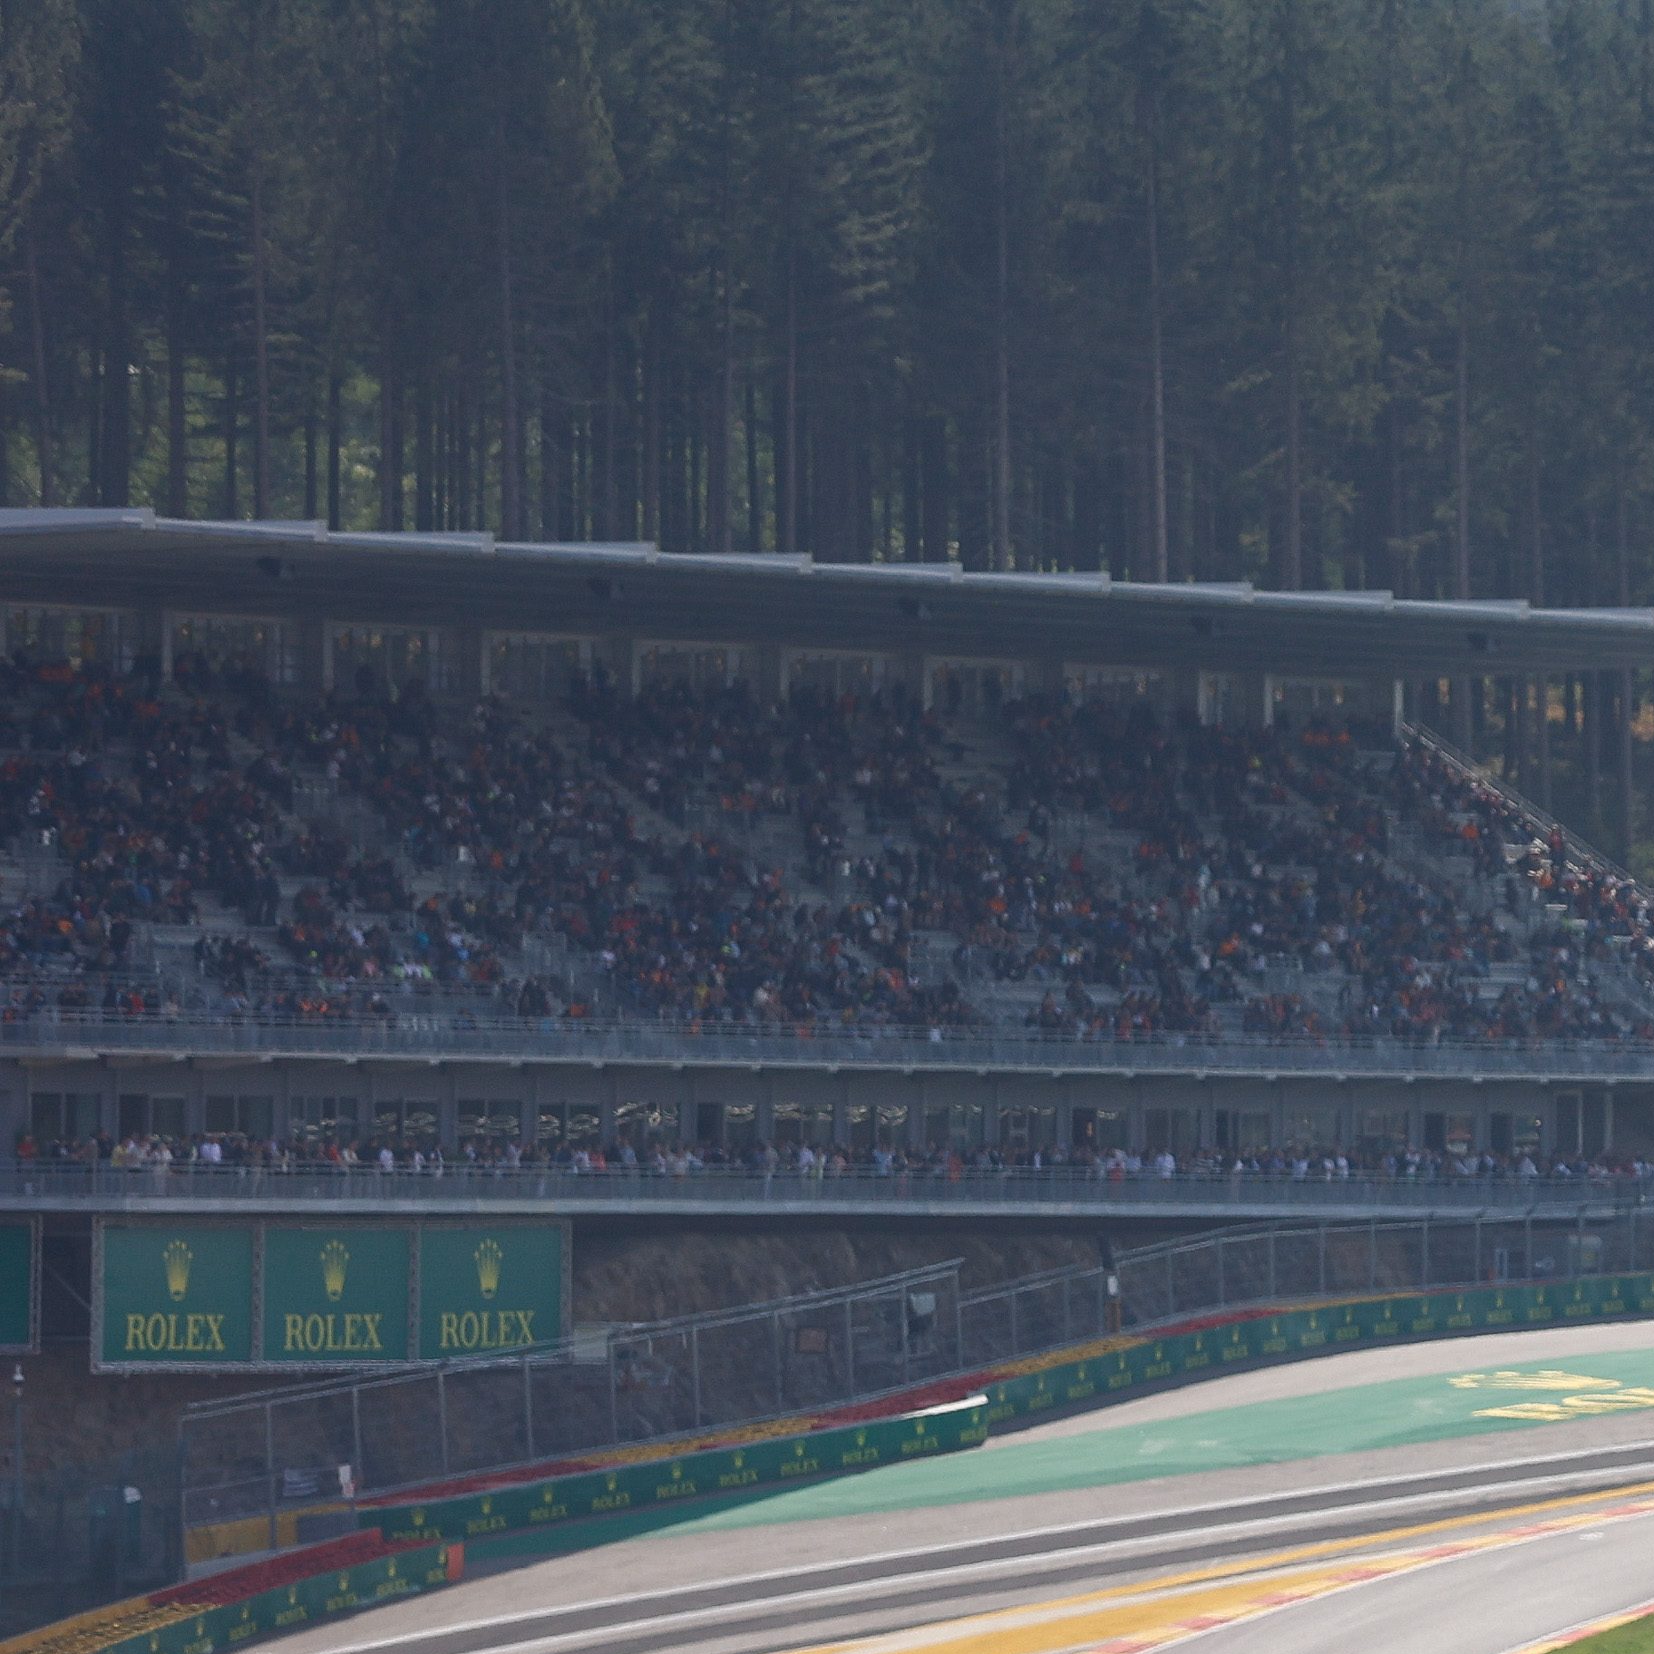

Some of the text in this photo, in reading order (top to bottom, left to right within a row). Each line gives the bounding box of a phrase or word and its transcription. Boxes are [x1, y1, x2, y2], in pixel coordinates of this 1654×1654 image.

[125, 1313, 226, 1352] ROLEX
[284, 1313, 382, 1352] ROLEX
[440, 1310, 537, 1349] ROLEX
